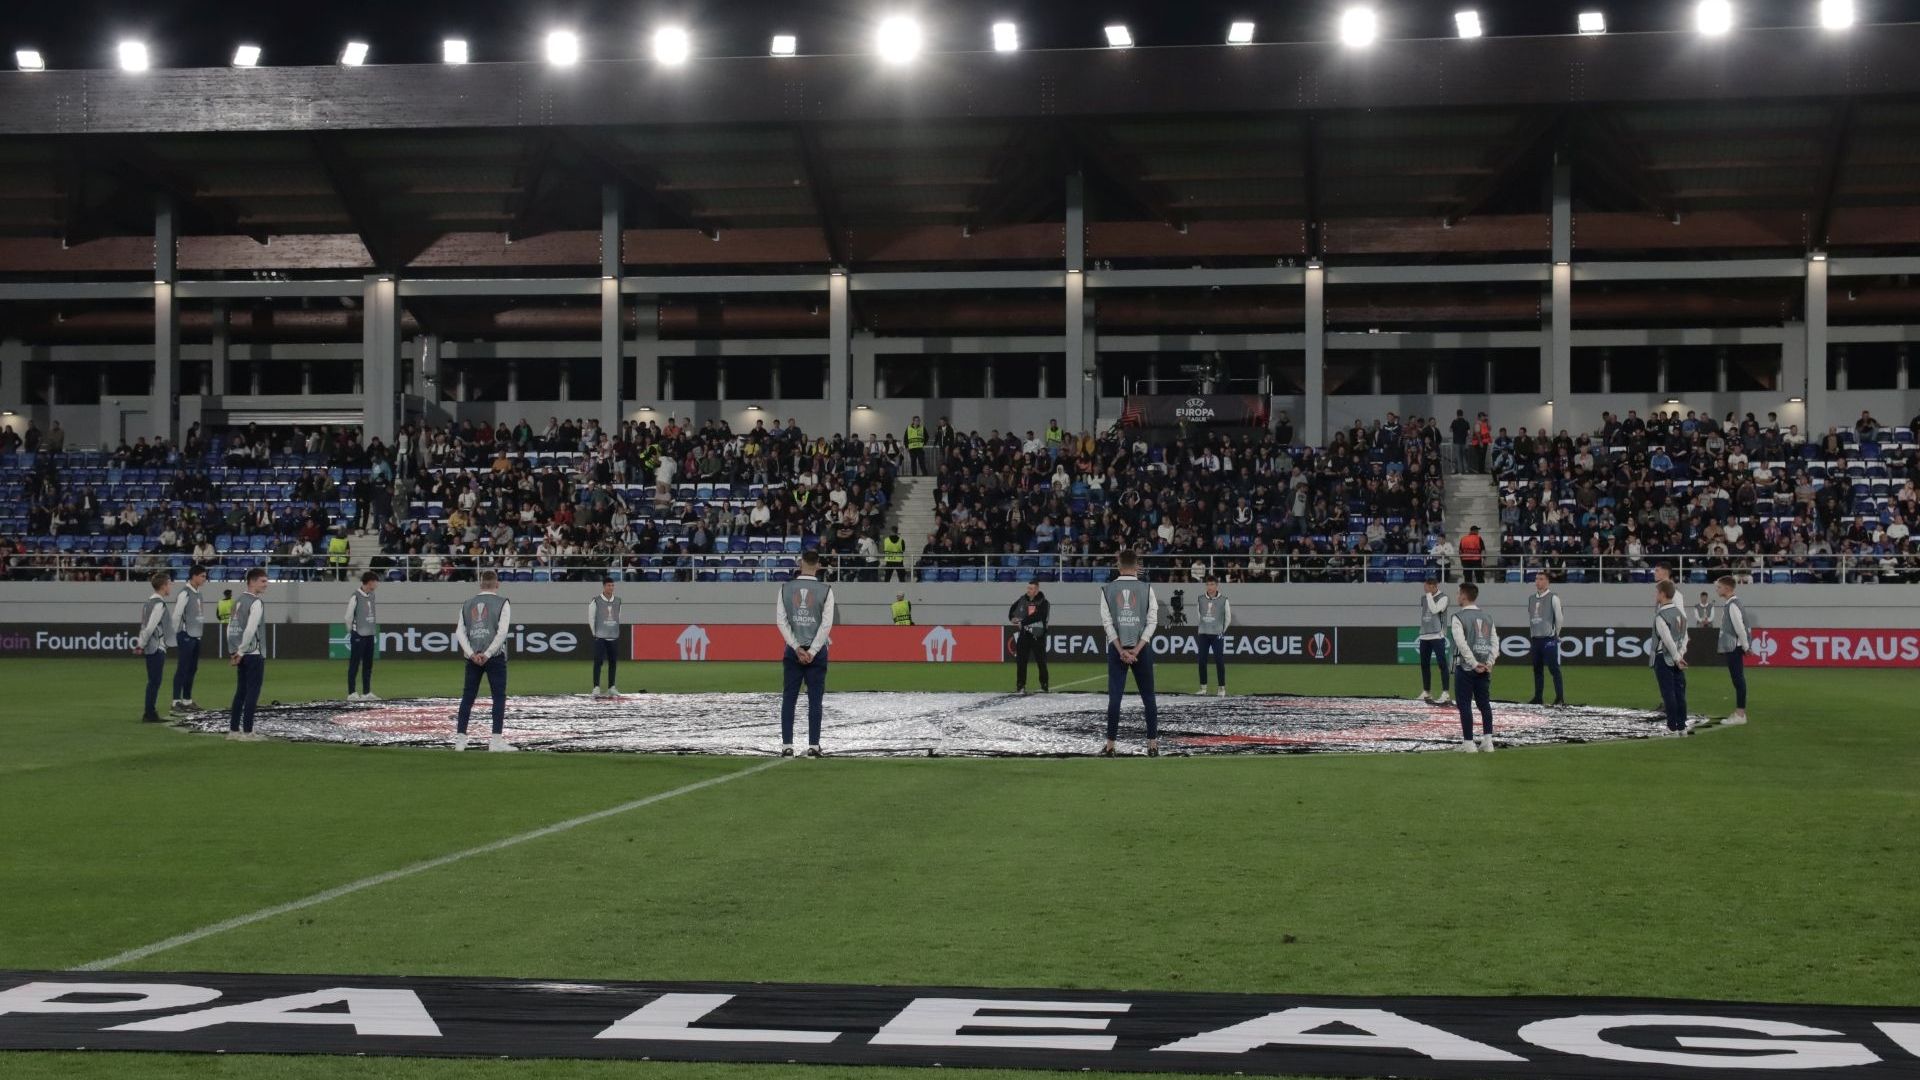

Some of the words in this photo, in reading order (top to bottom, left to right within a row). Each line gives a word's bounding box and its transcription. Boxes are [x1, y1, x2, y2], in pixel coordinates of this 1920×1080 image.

[1175, 408, 1215, 417] EUROPA
[0, 633, 31, 650] ain
[36, 631, 141, 650] Foundatio
[1105, 635, 1199, 655] OPA
[1208, 635, 1303, 655] EAGUE
[593, 993, 1920, 1070] LEAG
